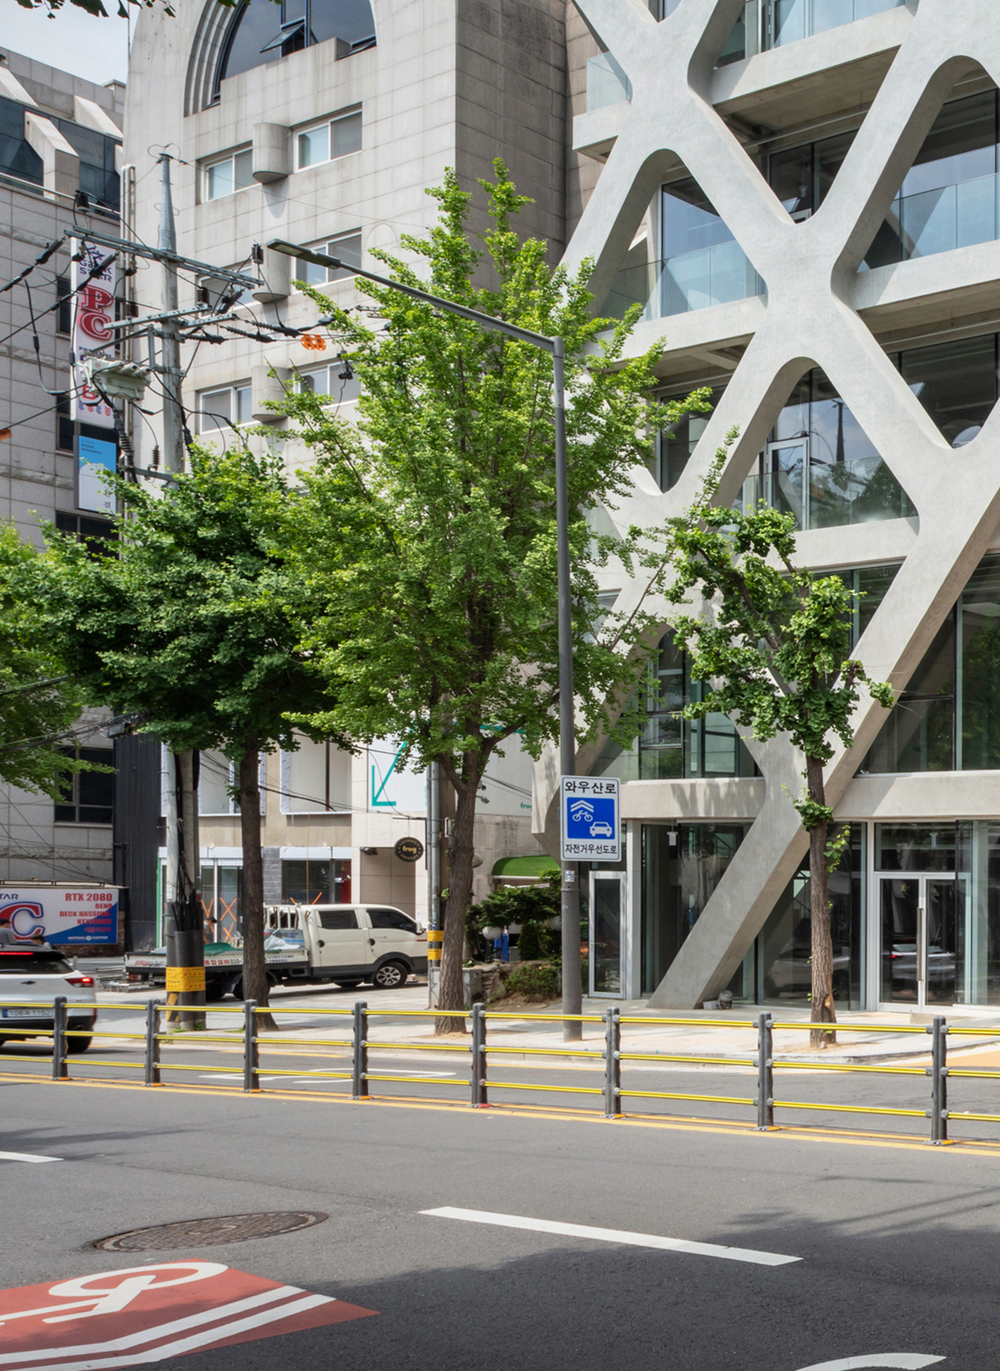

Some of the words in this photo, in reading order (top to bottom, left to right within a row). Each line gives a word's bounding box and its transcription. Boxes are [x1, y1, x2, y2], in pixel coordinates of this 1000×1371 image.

[79, 284, 114, 341] PC
[565, 781, 617, 794] 와우산로
[402, 845, 417, 855] frog
[565, 844, 617, 854] 자전거우선도로
[65, 893, 85, 902] RTX
[86, 893, 113, 902] 2080
